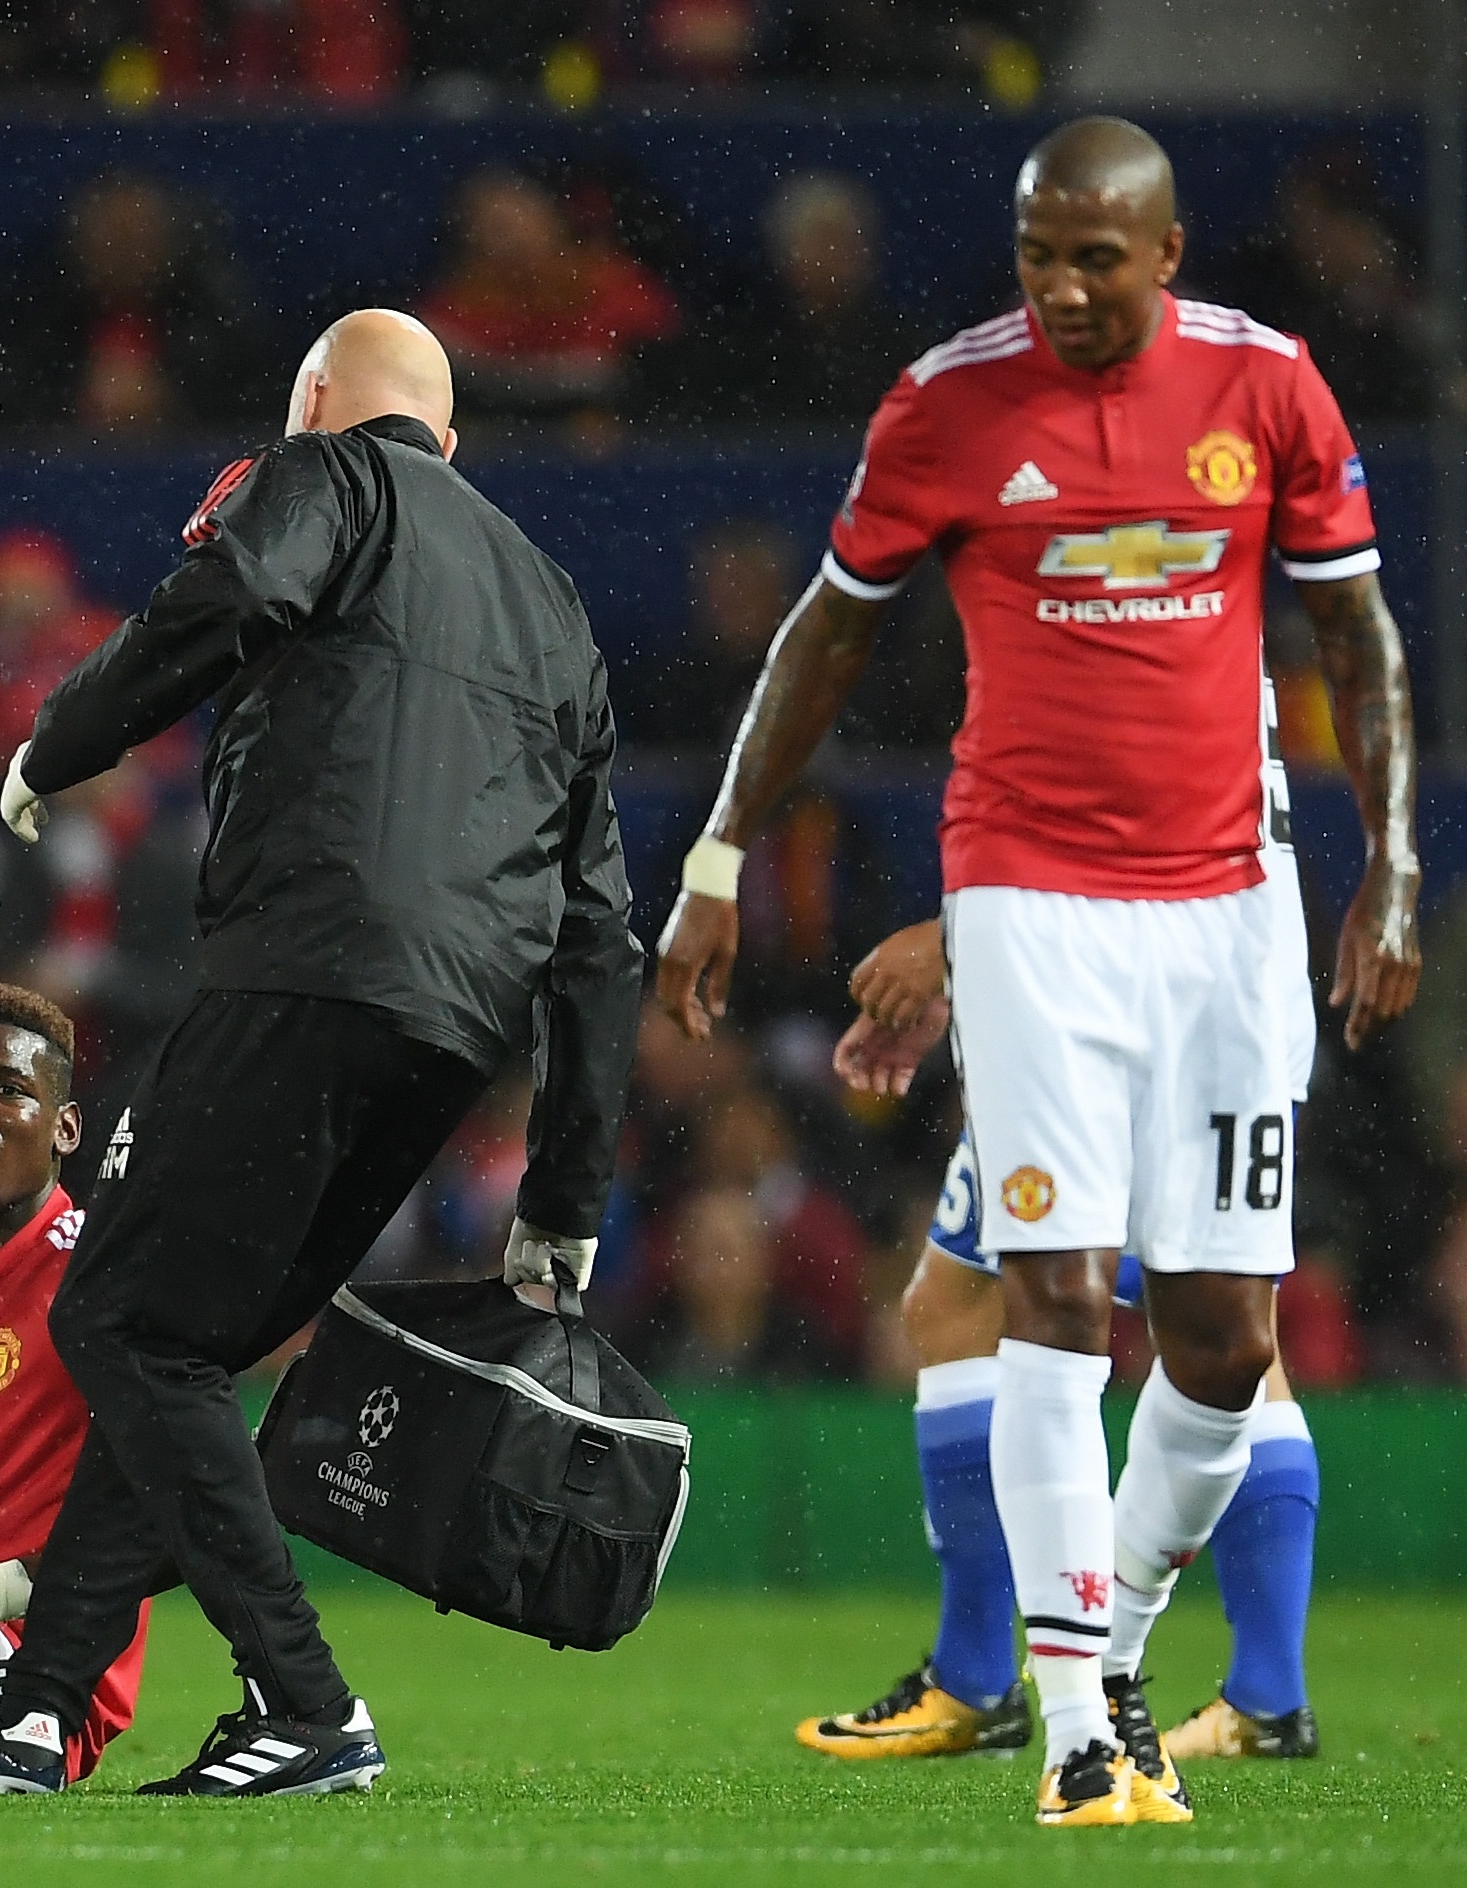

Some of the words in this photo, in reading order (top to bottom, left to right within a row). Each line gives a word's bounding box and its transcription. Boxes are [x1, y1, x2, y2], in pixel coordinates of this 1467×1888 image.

[1036, 591, 1225, 623] CHEVROLET
[1210, 1111, 1283, 1211] 18
[348, 1455, 370, 1476] UEFA
[318, 1461, 390, 1507] CHAMPIONS
[328, 1489, 366, 1516] LEAGUE
